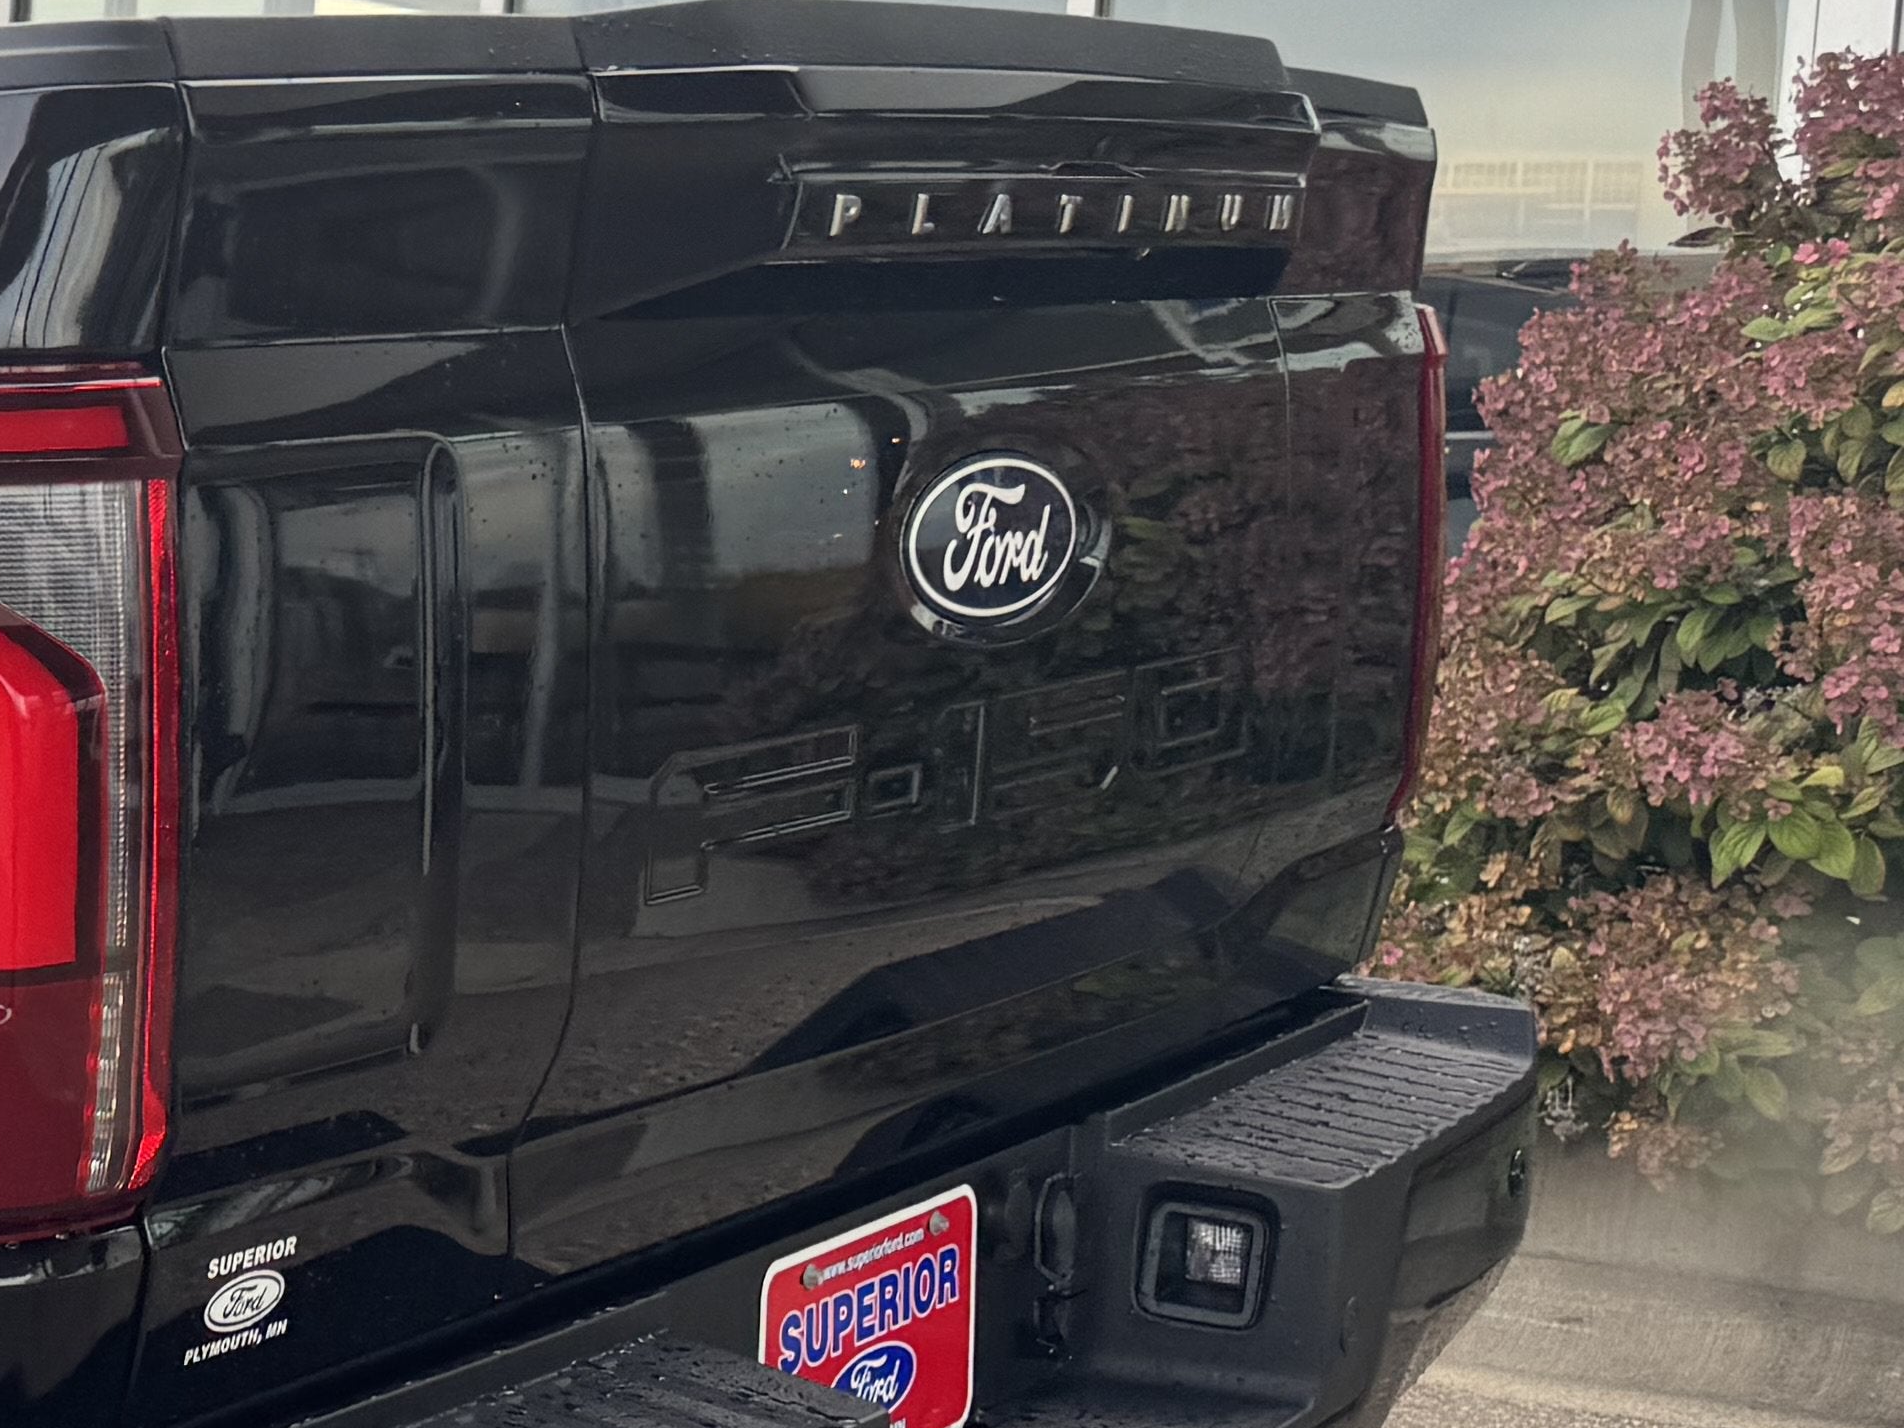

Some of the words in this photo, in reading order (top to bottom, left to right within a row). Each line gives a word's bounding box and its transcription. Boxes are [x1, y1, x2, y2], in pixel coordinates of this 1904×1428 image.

[828, 193, 1294, 236] PLATINUM
[943, 483, 1051, 593] Ford
[644, 647, 1248, 906] F-150
[207, 1235, 298, 1279] SUPERIOR
[222, 1284, 268, 1320] Ford
[777, 1243, 960, 1376] SUPERIOR
[183, 1327, 262, 1366] PLYMOUTH,
[265, 1318, 288, 1340] MN
